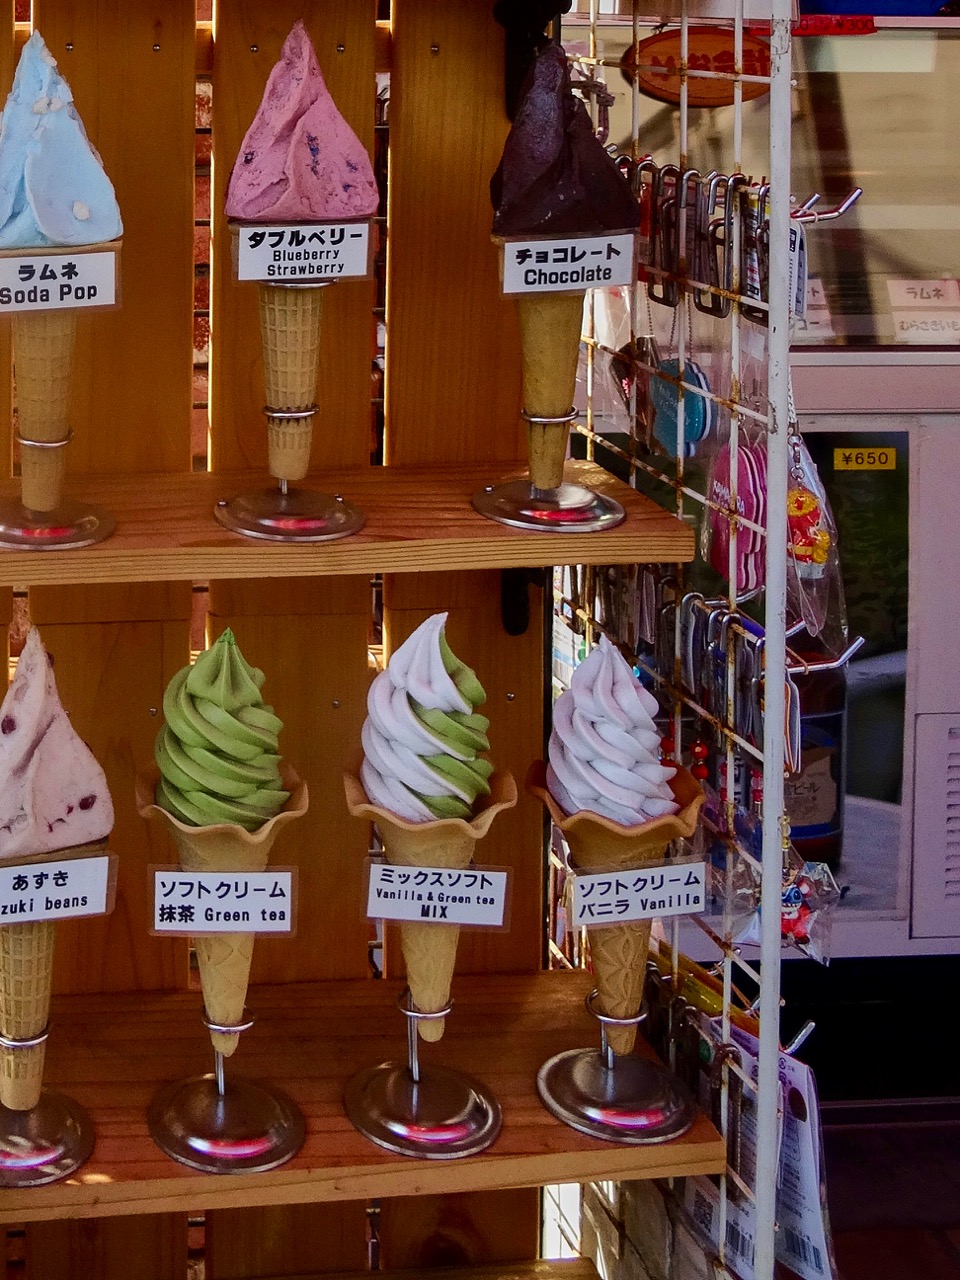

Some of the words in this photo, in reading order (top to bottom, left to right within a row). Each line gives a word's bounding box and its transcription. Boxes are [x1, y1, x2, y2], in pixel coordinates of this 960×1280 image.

[247, 228, 363, 249] ダブルベリー
[272, 249, 340, 262] Blueberry
[515, 243, 622, 265] チョコレート
[18, 262, 79, 282] ラムネ
[267, 263, 345, 276] Strawberry
[524, 265, 612, 285] Chocolate
[59, 284, 98, 302] Pop
[906, 287, 944, 300] ラムネ
[842, 452, 888, 465] ¥650
[11, 871, 69, 891] あずき
[380, 868, 493, 890] ミックスソフト
[579, 871, 701, 898] ソフトクリーム
[160, 880, 286, 899] ソフトクリーム
[44, 894, 88, 911] beans
[476, 895, 495, 905] tea
[579, 899, 630, 918] バニラ
[640, 894, 701, 911] Vanilla
[158, 904, 195, 923] 抹茶
[204, 907, 250, 922] Green
[260, 908, 286, 922] tea
[420, 904, 449, 919] MIX
